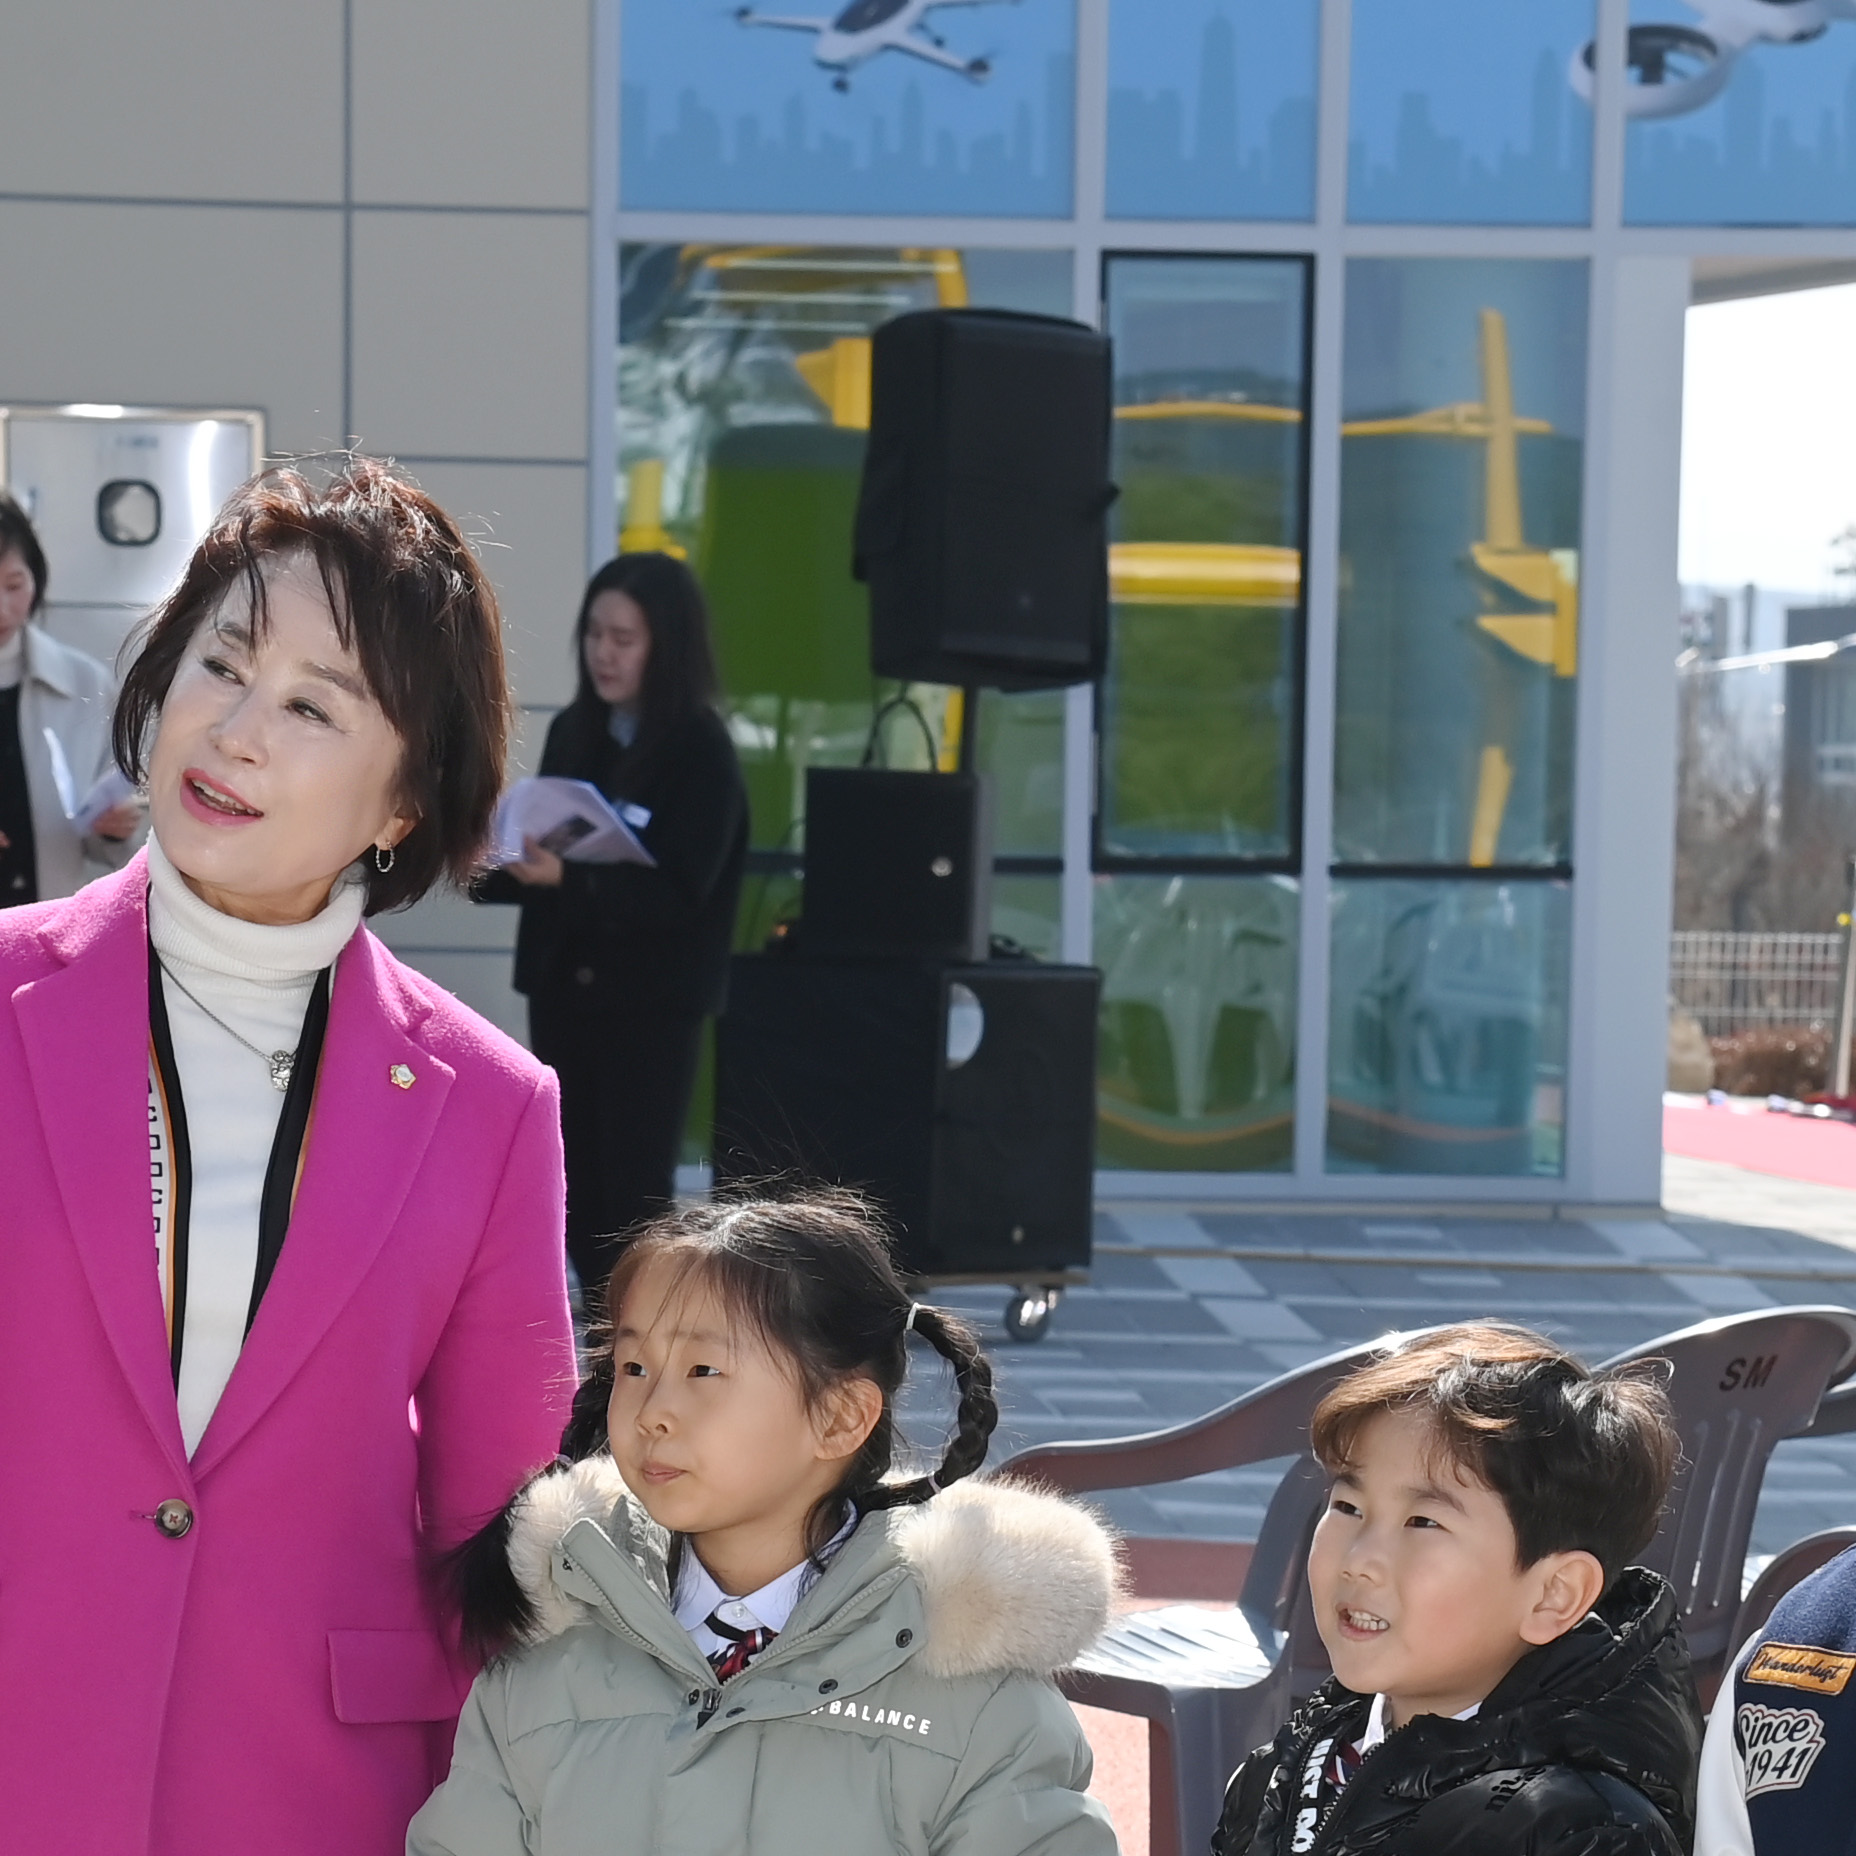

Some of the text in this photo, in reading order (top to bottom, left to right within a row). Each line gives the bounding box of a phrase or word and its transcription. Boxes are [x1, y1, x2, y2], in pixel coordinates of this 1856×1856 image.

[1717, 1353, 1779, 1392] SM
[1756, 1652, 1848, 1684] Wanderlust
[828, 1699, 932, 1736] BALANCE
